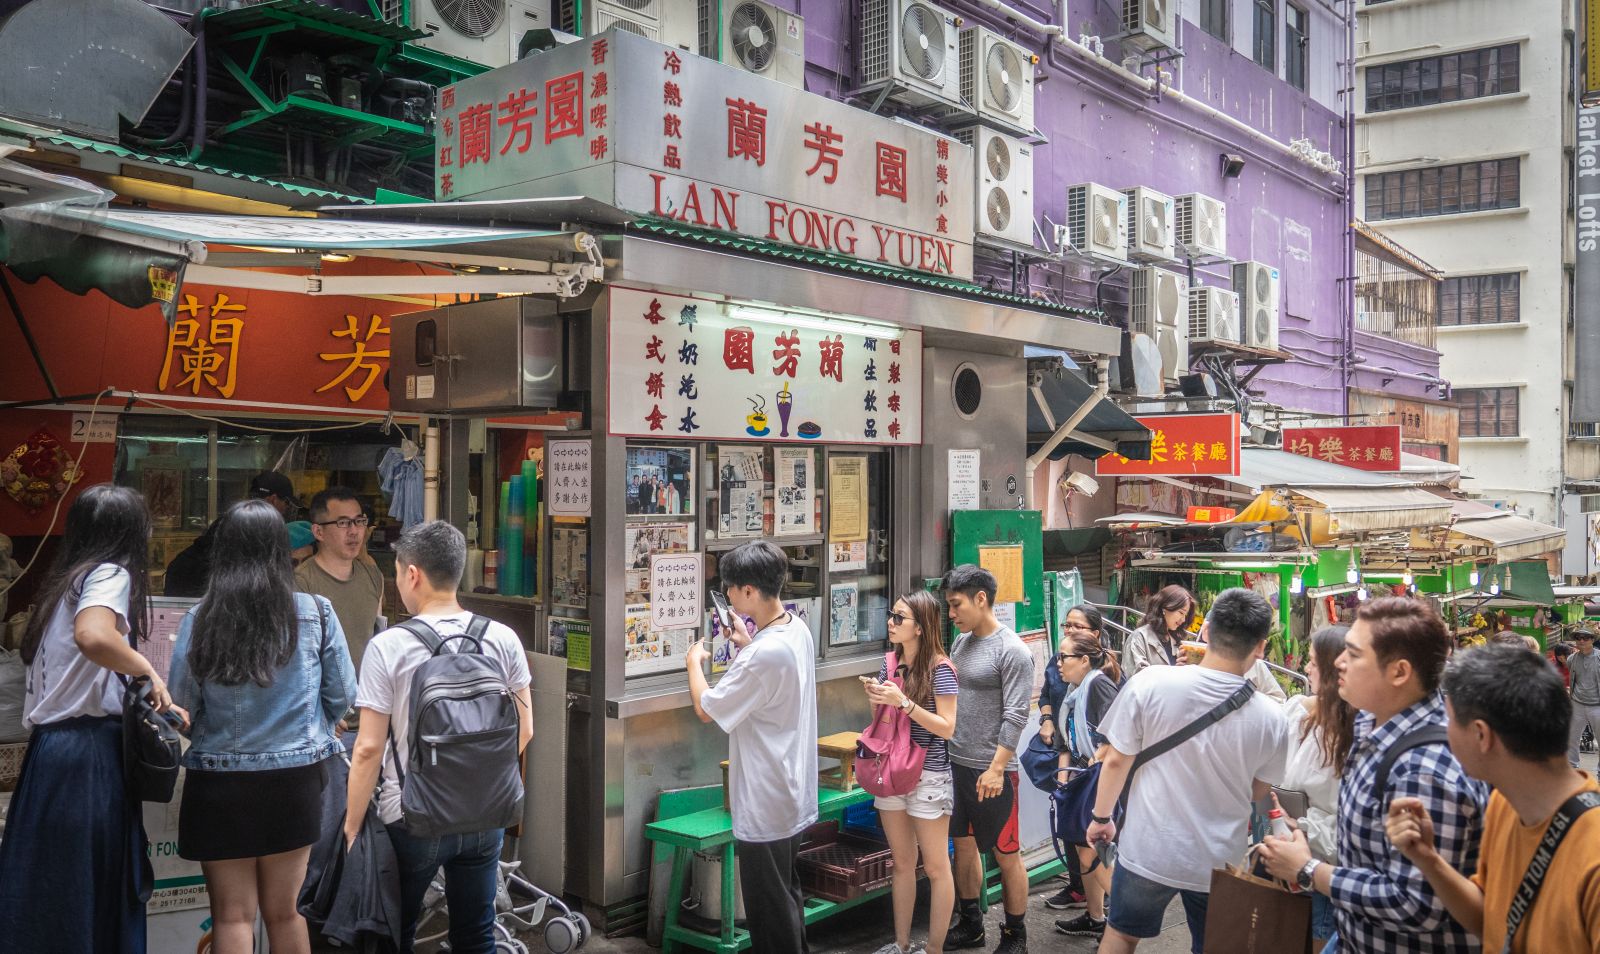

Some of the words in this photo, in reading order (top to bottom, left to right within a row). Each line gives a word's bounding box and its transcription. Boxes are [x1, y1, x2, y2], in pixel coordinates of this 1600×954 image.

[440, 88, 456, 197] 西冷紅茶
[458, 70, 585, 169] 蘭芳園
[663, 50, 683, 170] 冷熱飲品
[1578, 104, 1600, 178] arket
[725, 97, 908, 203] 蘭芳園
[936, 138, 949, 234] 精美小食
[648, 173, 739, 231] LAN
[764, 199, 857, 255] FONG
[871, 224, 955, 275] YUEN
[1578, 193, 1600, 252] Lofts
[158, 293, 391, 402] 蘭芳
[643, 298, 668, 431] 各式餅食
[73, 419, 85, 436] 2
[553, 462, 589, 473] 請在此輪候
[553, 492, 589, 505] 多謝合作
[657, 575, 696, 588] 請在此輪候
[657, 605, 696, 619] 多謝合作
[157, 841, 180, 856] FON
[1522, 848, 1552, 898] WOLF
